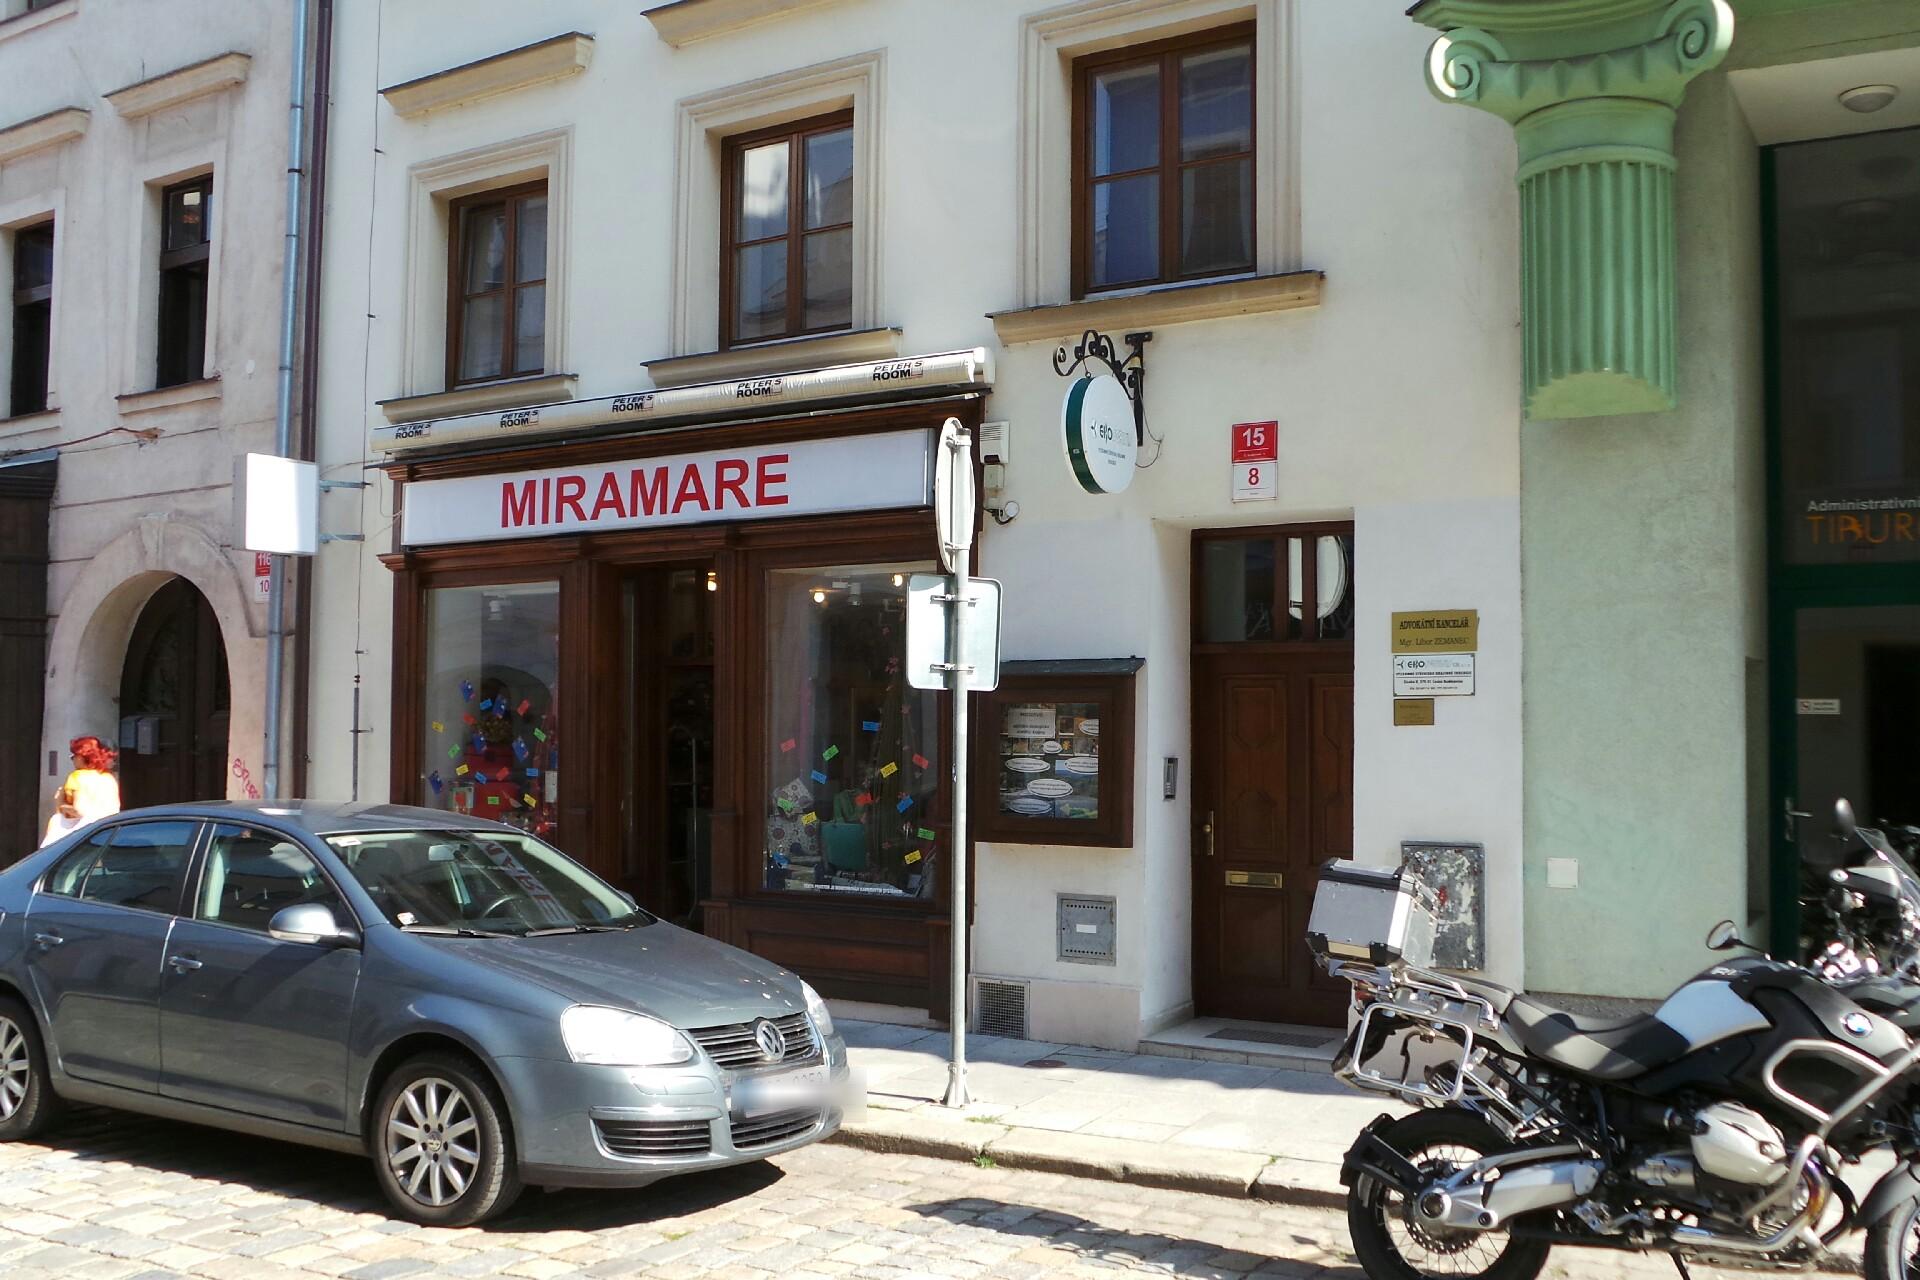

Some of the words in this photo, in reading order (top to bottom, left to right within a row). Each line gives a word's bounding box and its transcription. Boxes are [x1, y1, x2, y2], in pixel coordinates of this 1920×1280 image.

[873, 369, 911, 381] ROOM
[736, 387, 772, 398] ROOM
[612, 402, 644, 413] ROOM
[500, 417, 529, 428] ROOM
[395, 429, 422, 440] ROOM
[1242, 427, 1265, 447] 15
[1248, 467, 1260, 486] 8
[500, 453, 789, 528] MIRAMARE
[260, 580, 270, 593] 10
